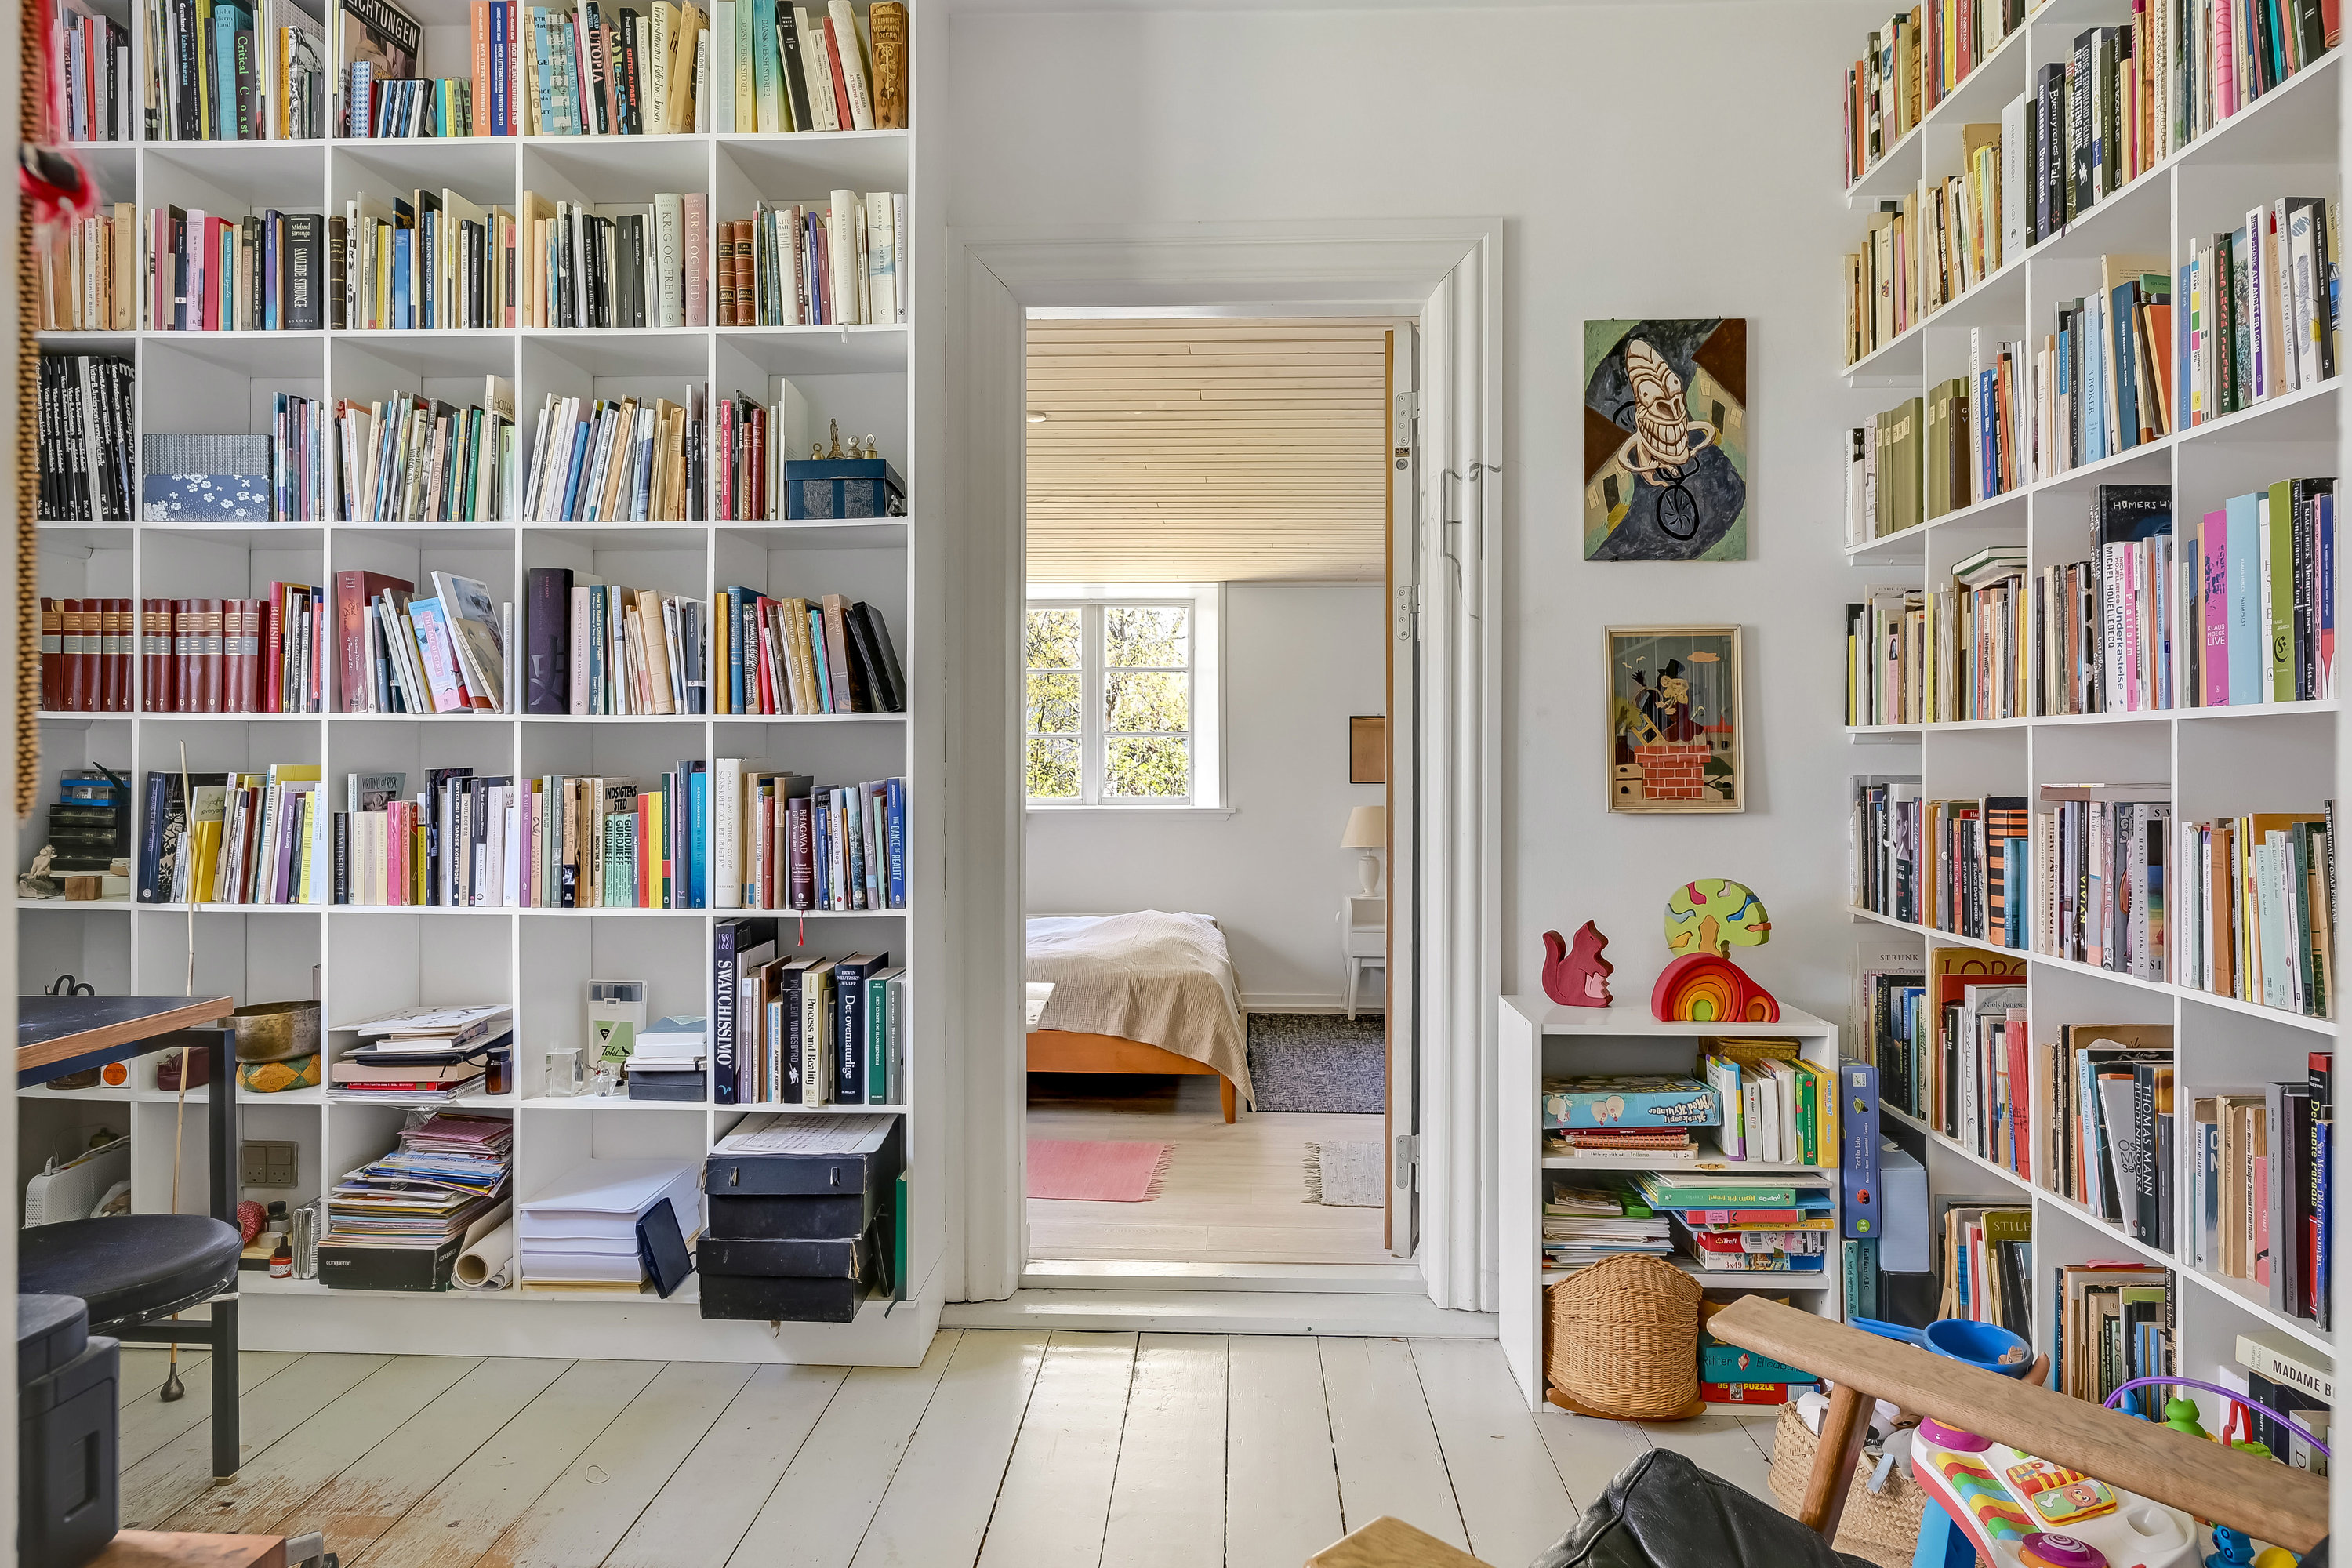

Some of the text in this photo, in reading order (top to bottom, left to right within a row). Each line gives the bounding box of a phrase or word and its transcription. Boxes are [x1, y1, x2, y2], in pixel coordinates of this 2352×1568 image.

[238, 36, 249, 75] Critical
[589, 31, 604, 83] UTOPIA
[761, 44, 770, 93] VERSHISTORIE
[853, 100, 862, 115] DAGEN
[855, 74, 866, 109] ANDERS OLSSON
[2049, 90, 2060, 187] Eventyrenes Tale
[293, 247, 307, 308] SAMLEDE STRUNGE
[662, 212, 674, 300] KRIG OG FRED
[689, 212, 699, 301] KRIG OG FRED
[432, 461, 441, 493] BLODSTENEN
[2112, 500, 2157, 510] HOMERS
[270, 606, 279, 649] BUBISHI
[797, 610, 805, 634] BHAGAVAD
[832, 604, 840, 635] DIAMOND
[2107, 584, 2115, 648] HOUELLEBECQ
[432, 655, 441, 674] GENJI
[786, 611, 801, 683] DHAMMAPADA EASWARAN
[2115, 605, 2125, 690] Underkastelse
[455, 815, 459, 823] AF
[799, 808, 808, 854] BHAGAVAD
[833, 813, 841, 849] Sangenes
[890, 826, 901, 847] DANCE
[604, 819, 613, 866] GURDJIEFF
[615, 819, 624, 866] GURDJIEFF
[623, 819, 632, 865] GURDJIEFF
[891, 854, 902, 881] REALITY
[717, 960, 732, 1065] SWATCHISSIMO
[789, 1003, 800, 1062] LEVI VIDNESBYRD
[601, 1044, 629, 1058] Toki
[805, 997, 816, 1085] Process and Reality
[842, 995, 855, 1079] Det overnaturlige
[2133, 1082, 2142, 1192] BUDDENBROOKS
[2142, 1084, 2153, 1196] THOMAS MANN
[1759, 1193, 1781, 1202] pop-op
[1994, 1221, 2031, 1232] STILH
[326, 1259, 351, 1269] conqueror
[1704, 1355, 1733, 1367] Ritter
[2273, 1359, 2321, 1392] MADAME
